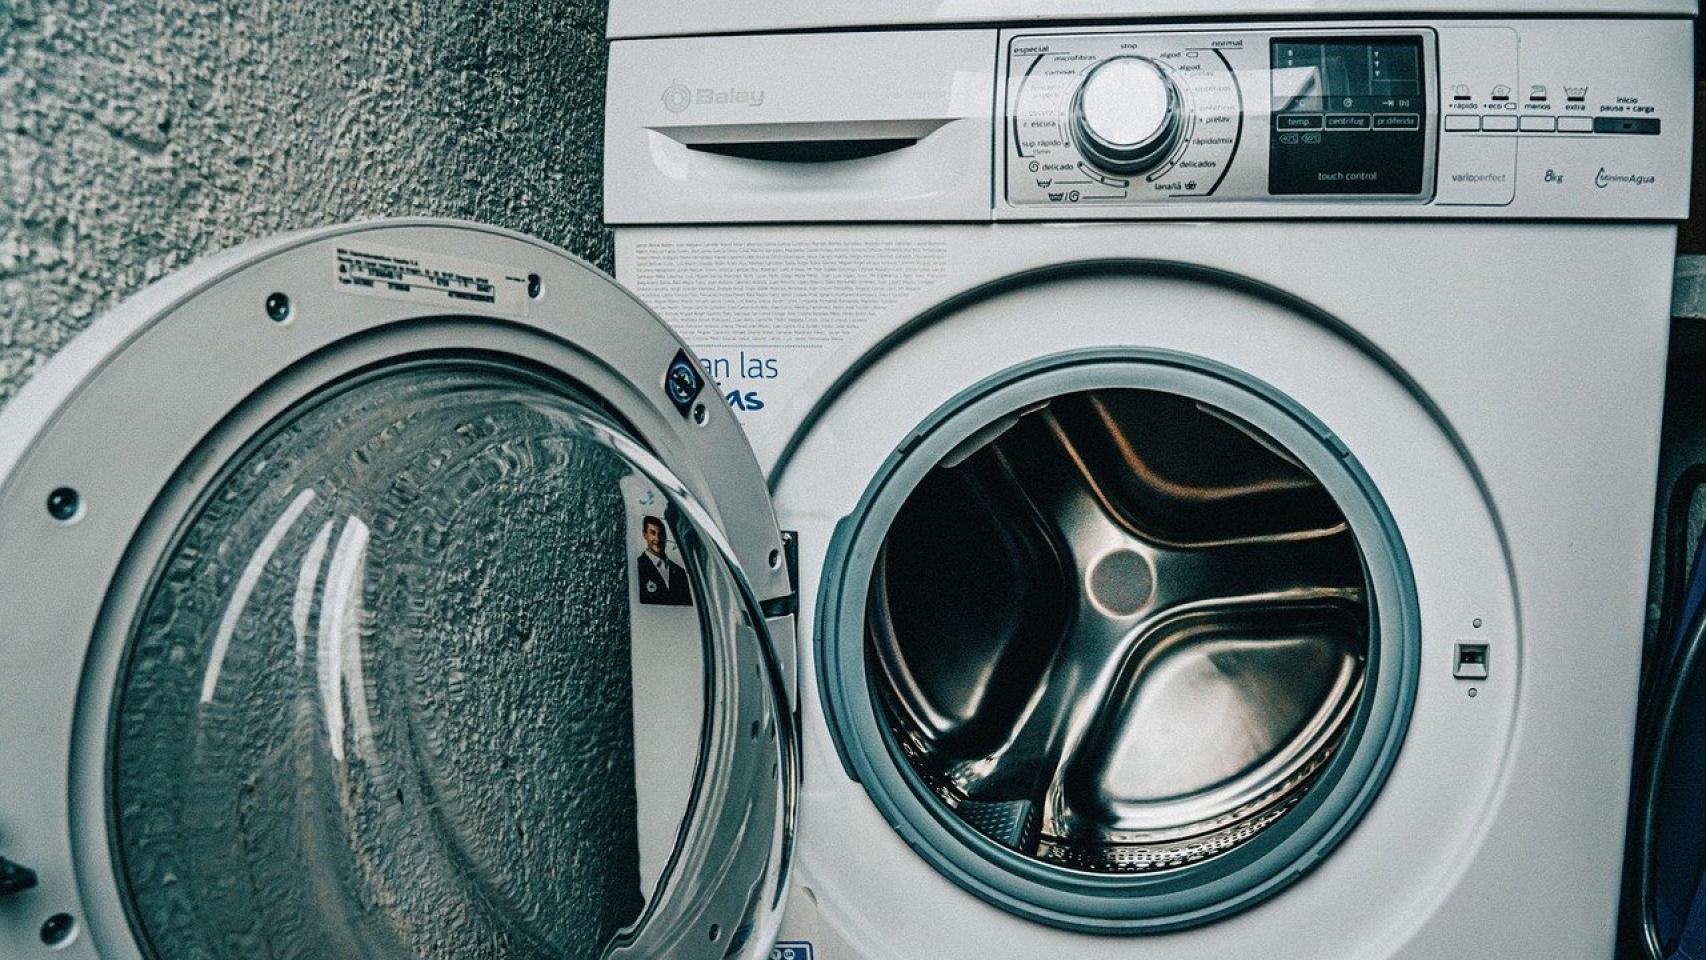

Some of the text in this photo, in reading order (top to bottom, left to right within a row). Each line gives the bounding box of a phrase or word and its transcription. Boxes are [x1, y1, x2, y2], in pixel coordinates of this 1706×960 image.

[1014, 46, 1049, 54] especial
[696, 88, 765, 107] Balay
[1600, 105, 1624, 113] pausa
[1633, 105, 1655, 114] carga
[1041, 163, 1073, 171] delicado
[1180, 160, 1216, 168] delicados
[1318, 171, 1377, 180] touch control
[1452, 173, 1506, 183] varioperfect
[1544, 169, 1563, 184] 8kg
[740, 351, 778, 378] las
